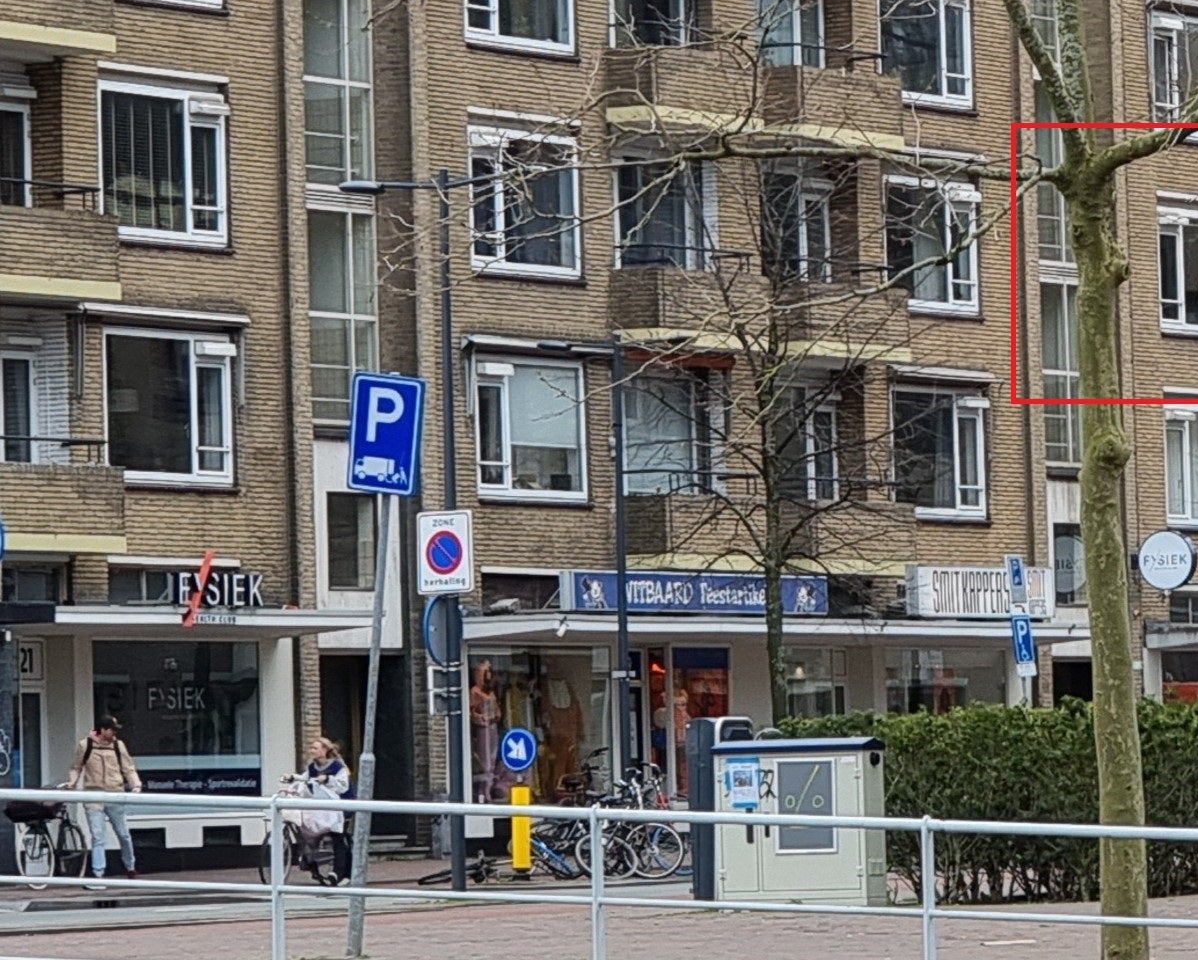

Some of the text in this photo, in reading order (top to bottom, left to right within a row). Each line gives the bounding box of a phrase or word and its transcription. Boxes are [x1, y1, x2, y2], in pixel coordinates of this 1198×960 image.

[366, 387, 404, 442] P
[432, 518, 455, 527] ZONE
[1143, 554, 1188, 568] FYSIEK
[179, 571, 264, 608] FYSIEK
[1017, 620, 1027, 645] P
[20, 647, 34, 673] 21
